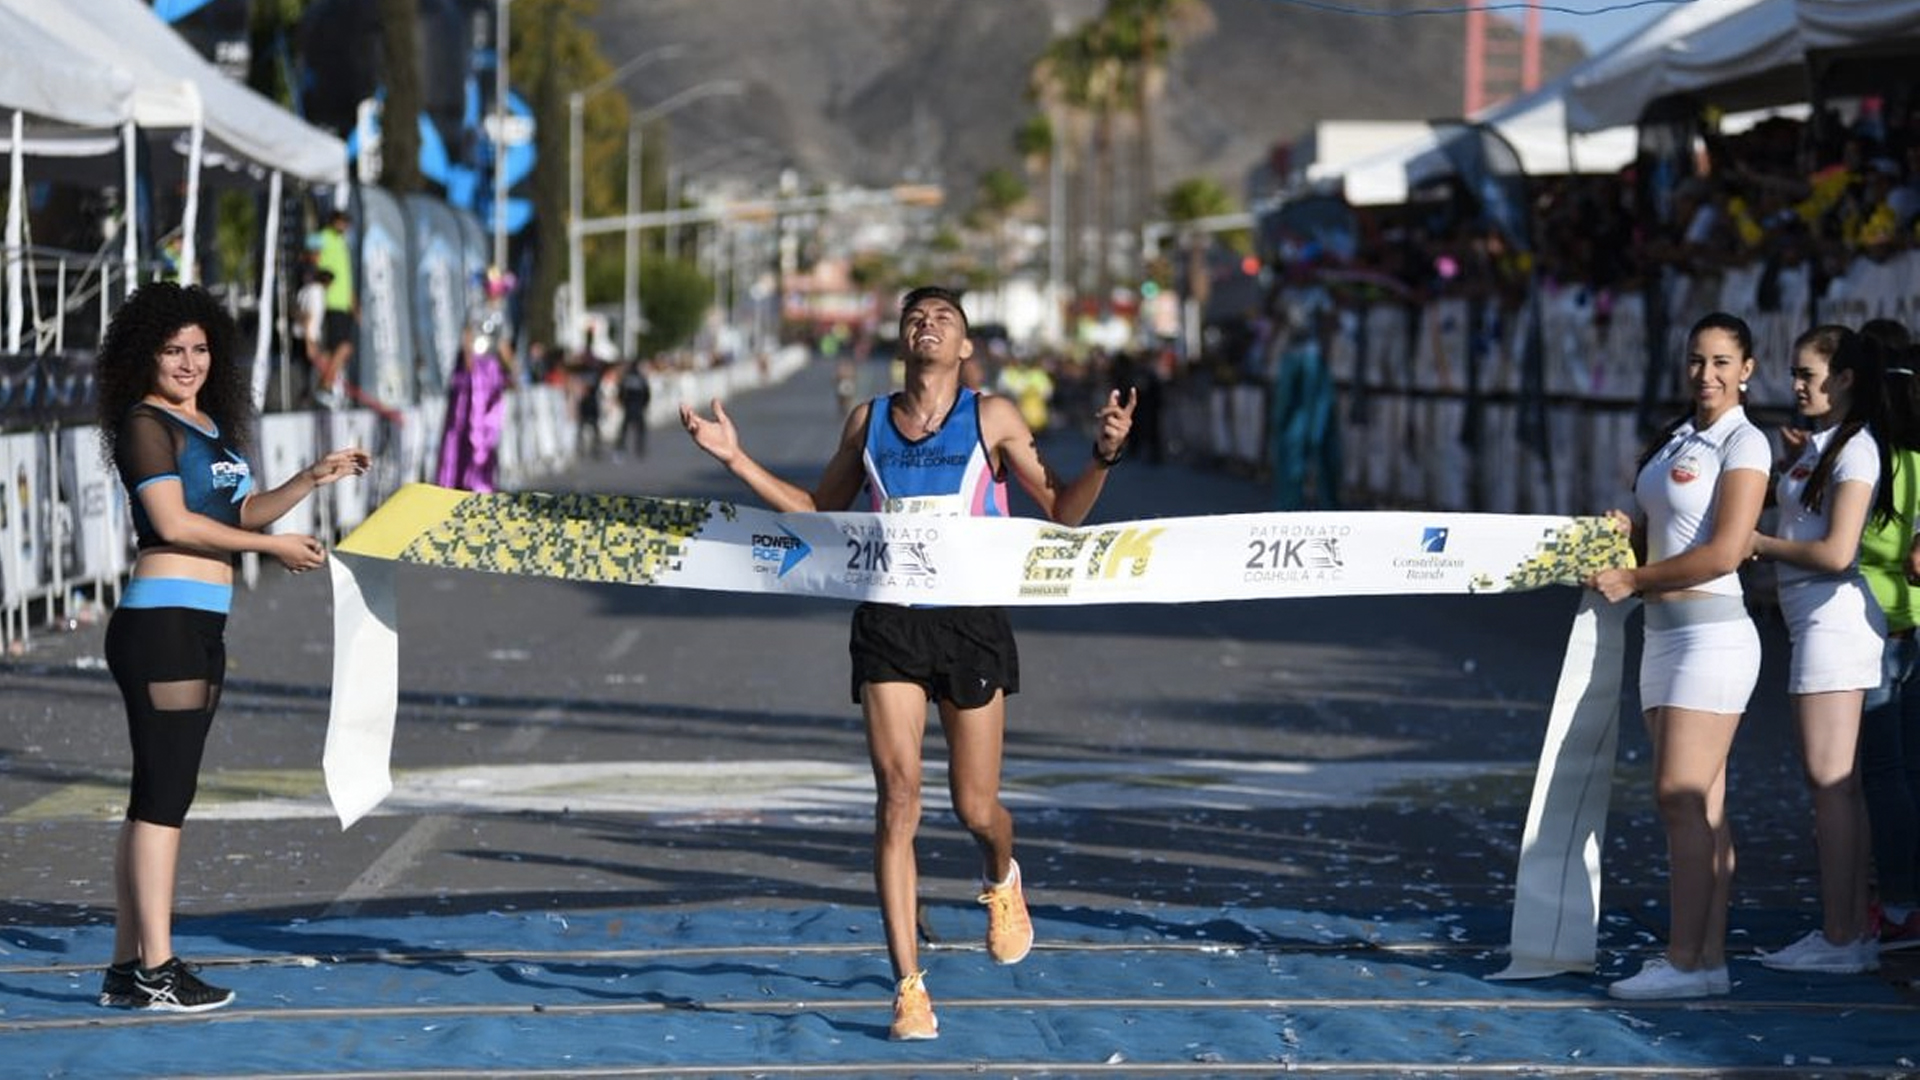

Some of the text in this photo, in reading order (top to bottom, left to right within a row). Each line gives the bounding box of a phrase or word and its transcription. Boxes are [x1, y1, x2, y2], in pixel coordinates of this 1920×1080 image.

[1250, 525, 1350, 538] PATRONATO
[751, 534, 801, 550] POWER
[846, 539, 889, 573] 21K
[1246, 539, 1306, 568] 21K
[1393, 557, 1465, 569] Constellation
[1244, 569, 1309, 582] COAHUILA
[1407, 569, 1444, 579] Brands
